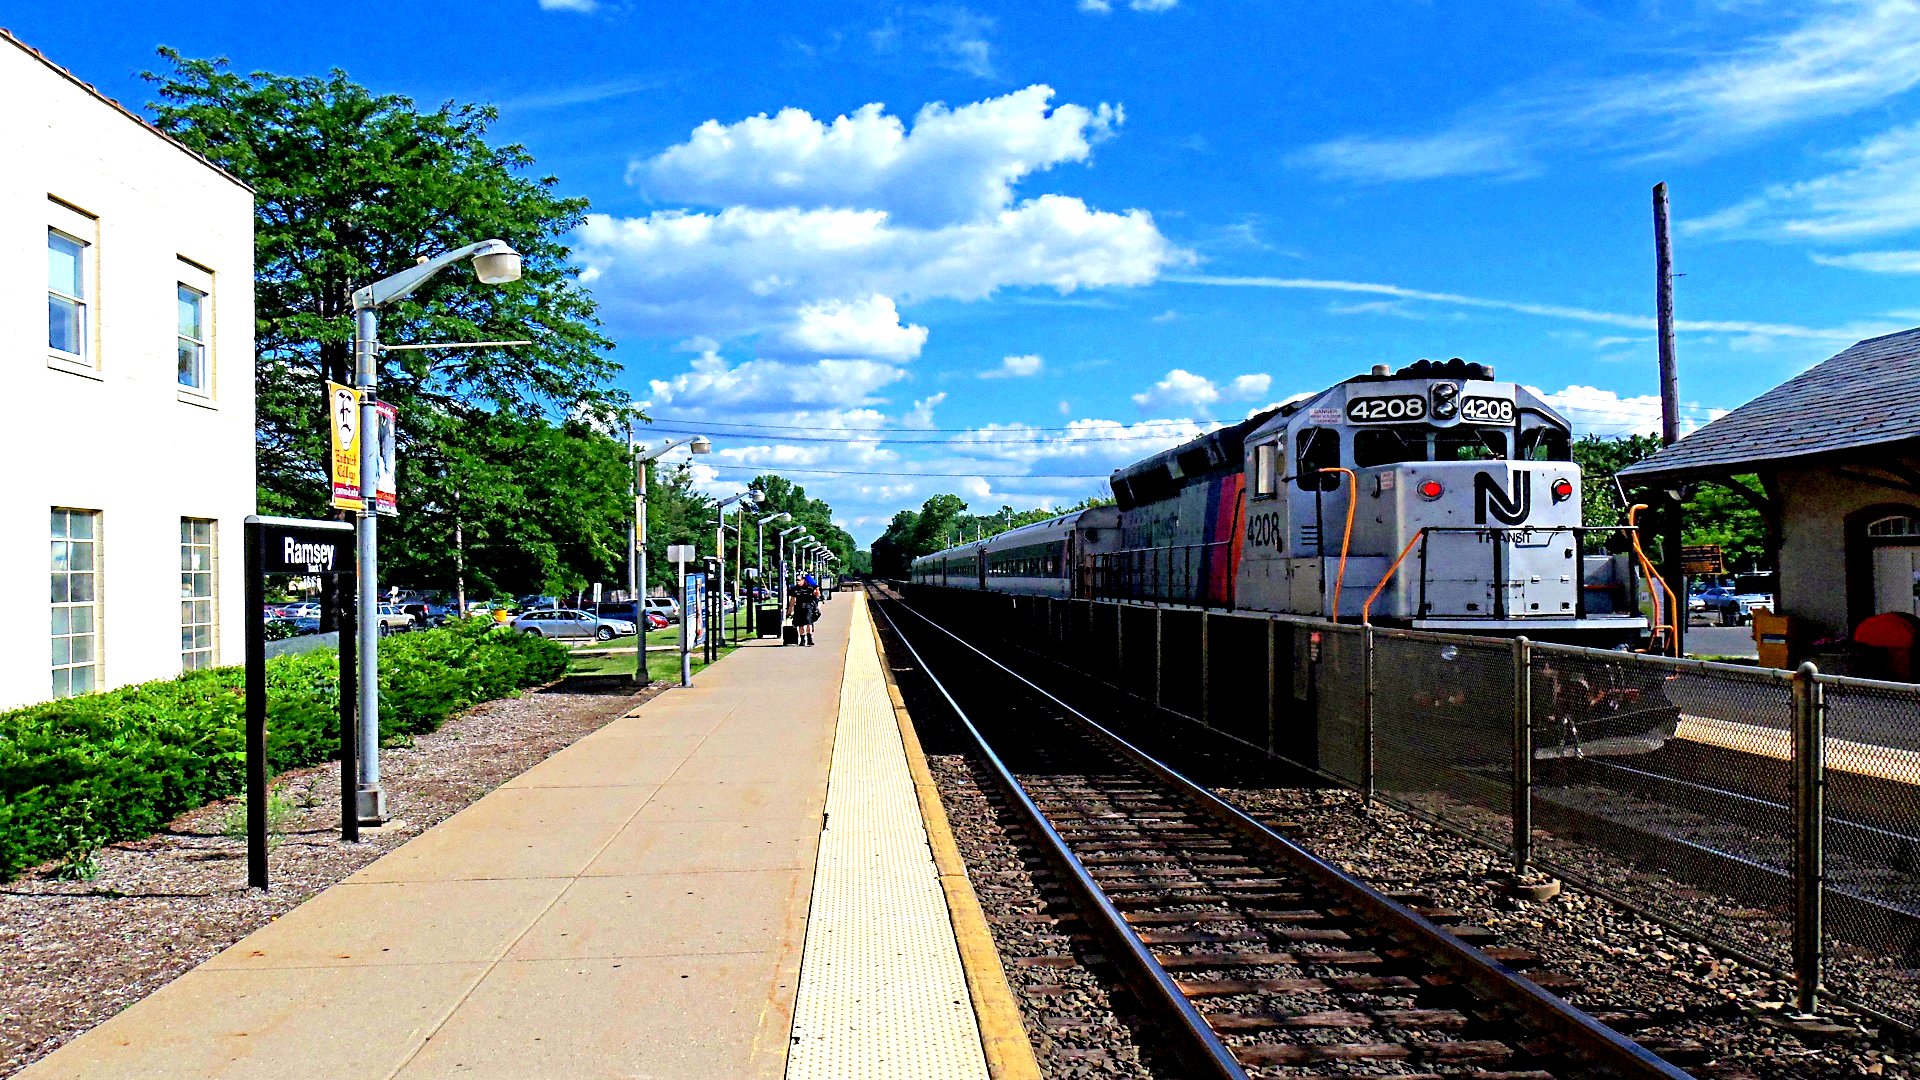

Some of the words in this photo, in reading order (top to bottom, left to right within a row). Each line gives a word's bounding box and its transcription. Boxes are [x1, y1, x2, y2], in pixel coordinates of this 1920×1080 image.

[1350, 399, 1424, 419] 4208
[1462, 399, 1513, 420] 4208
[1473, 469, 1531, 526] NJ
[1247, 511, 1280, 547] 4208
[284, 536, 335, 571] Ramsey
